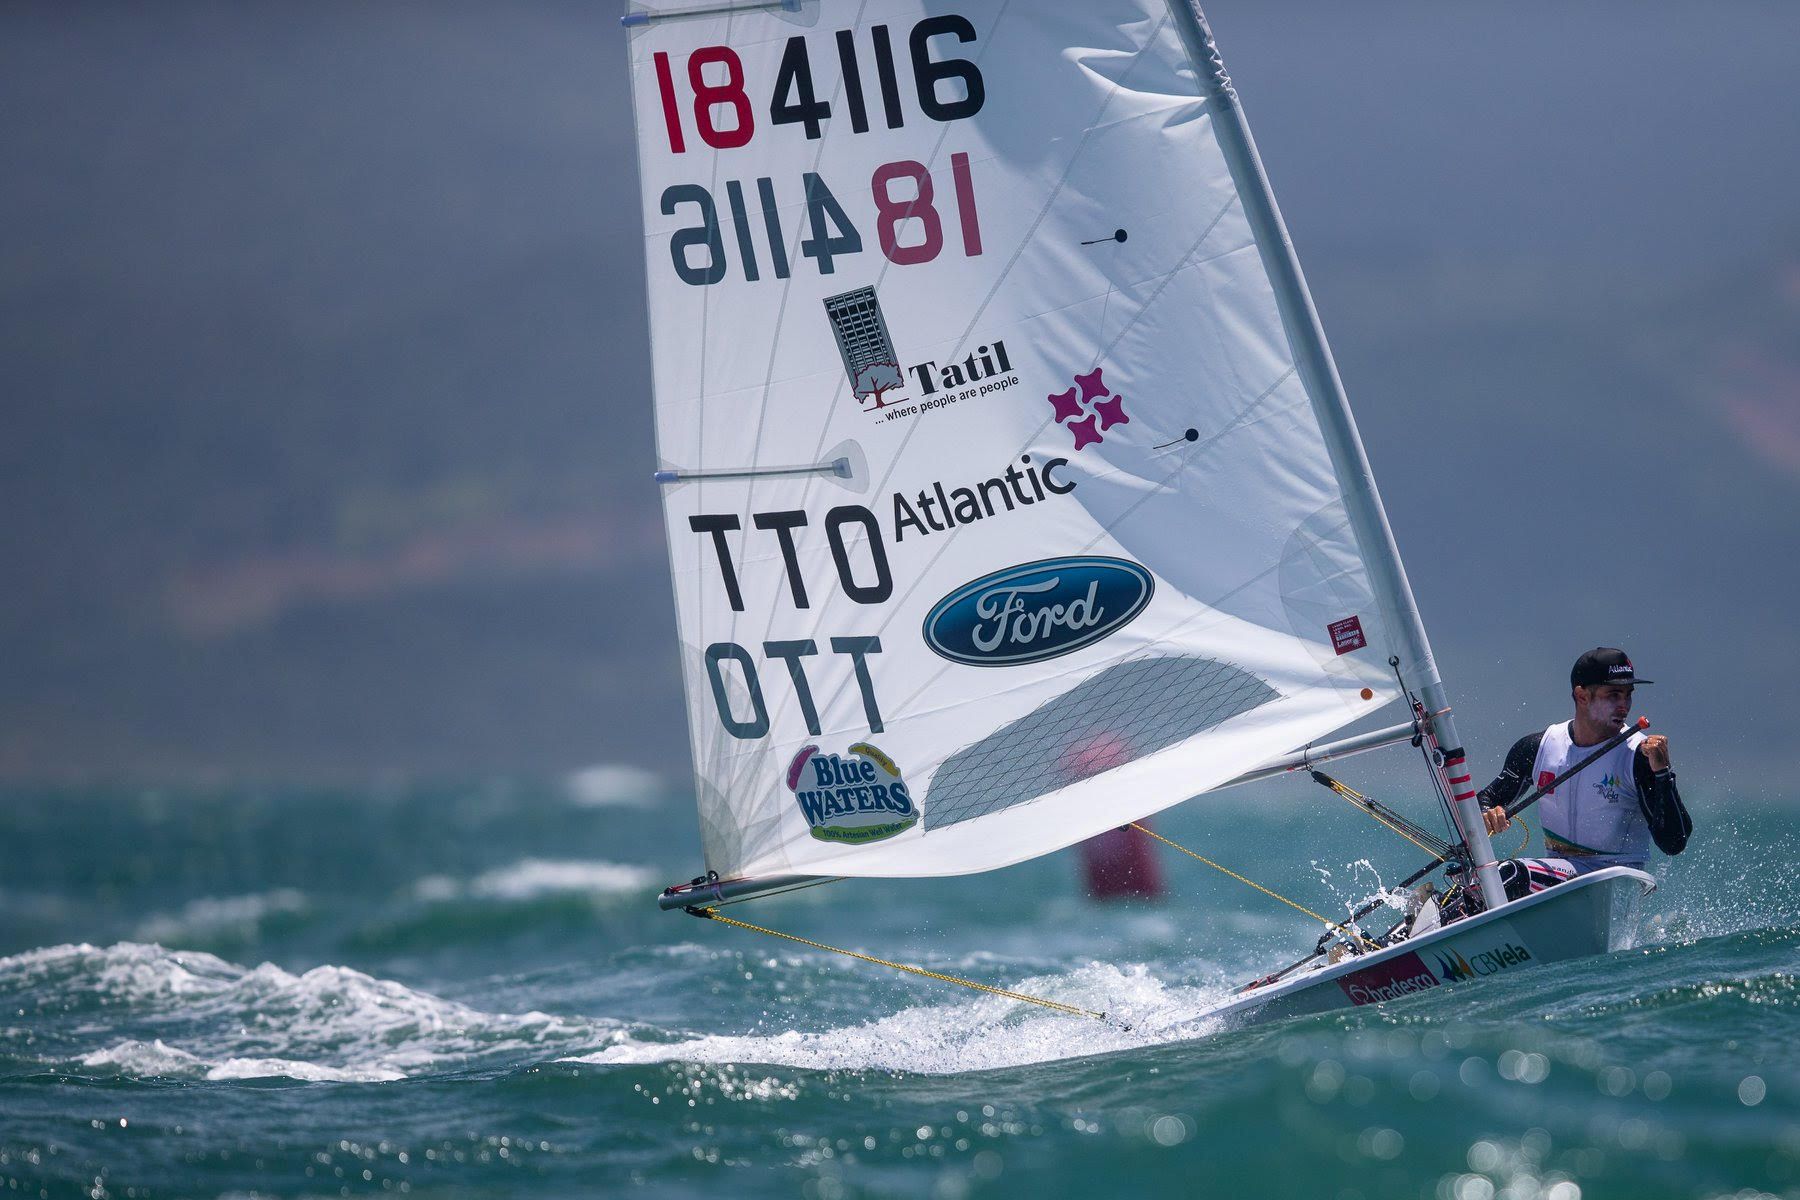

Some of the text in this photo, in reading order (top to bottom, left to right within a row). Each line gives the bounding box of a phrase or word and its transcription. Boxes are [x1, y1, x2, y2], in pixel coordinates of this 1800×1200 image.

[908, 340, 1015, 397] Tatil
[920, 393, 957, 414] people
[959, 388, 977, 401] are
[979, 376, 1019, 397] people
[893, 454, 1078, 543] Atlantic
[688, 505, 894, 612] TTO
[971, 576, 1105, 652] Ford
[811, 756, 876, 787] Blue
[798, 782, 912, 825] WATERS
[1470, 943, 1532, 976] CBVela
